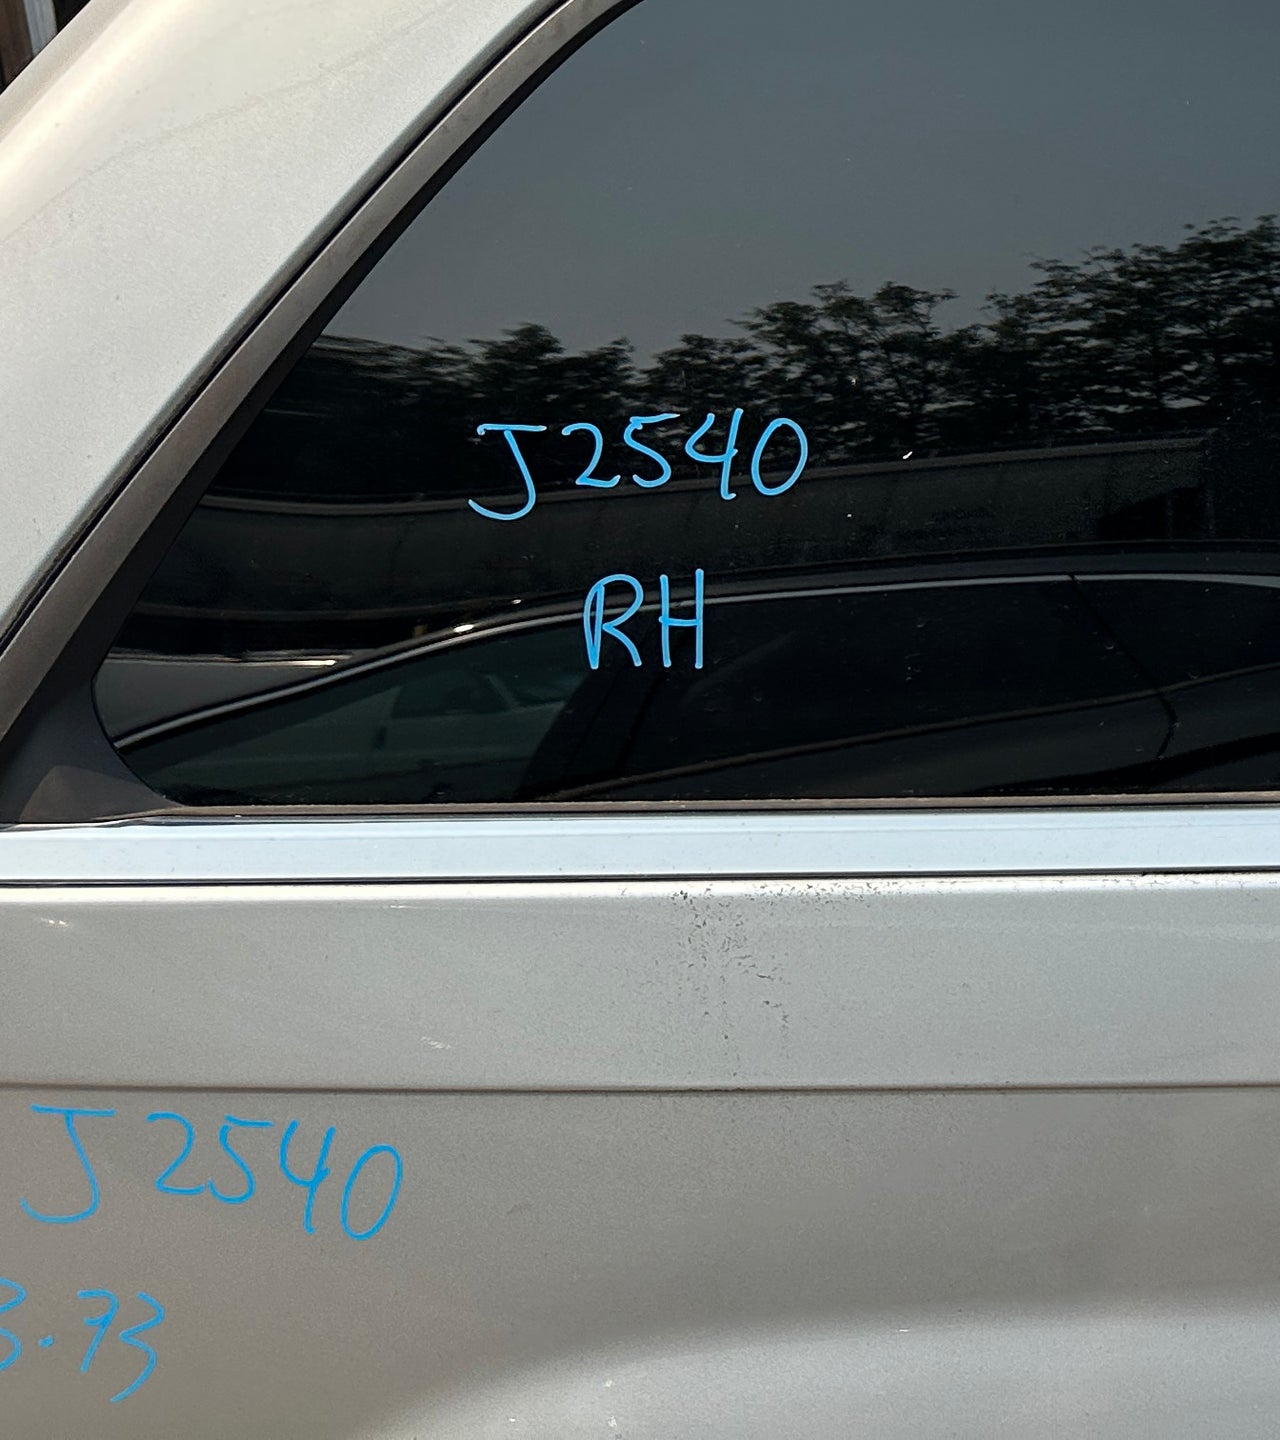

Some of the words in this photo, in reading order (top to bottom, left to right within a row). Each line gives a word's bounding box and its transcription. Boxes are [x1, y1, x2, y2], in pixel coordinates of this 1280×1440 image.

[467, 408, 809, 521] J2540
[583, 568, 705, 670] RH
[20, 1103, 403, 1241] J2540
